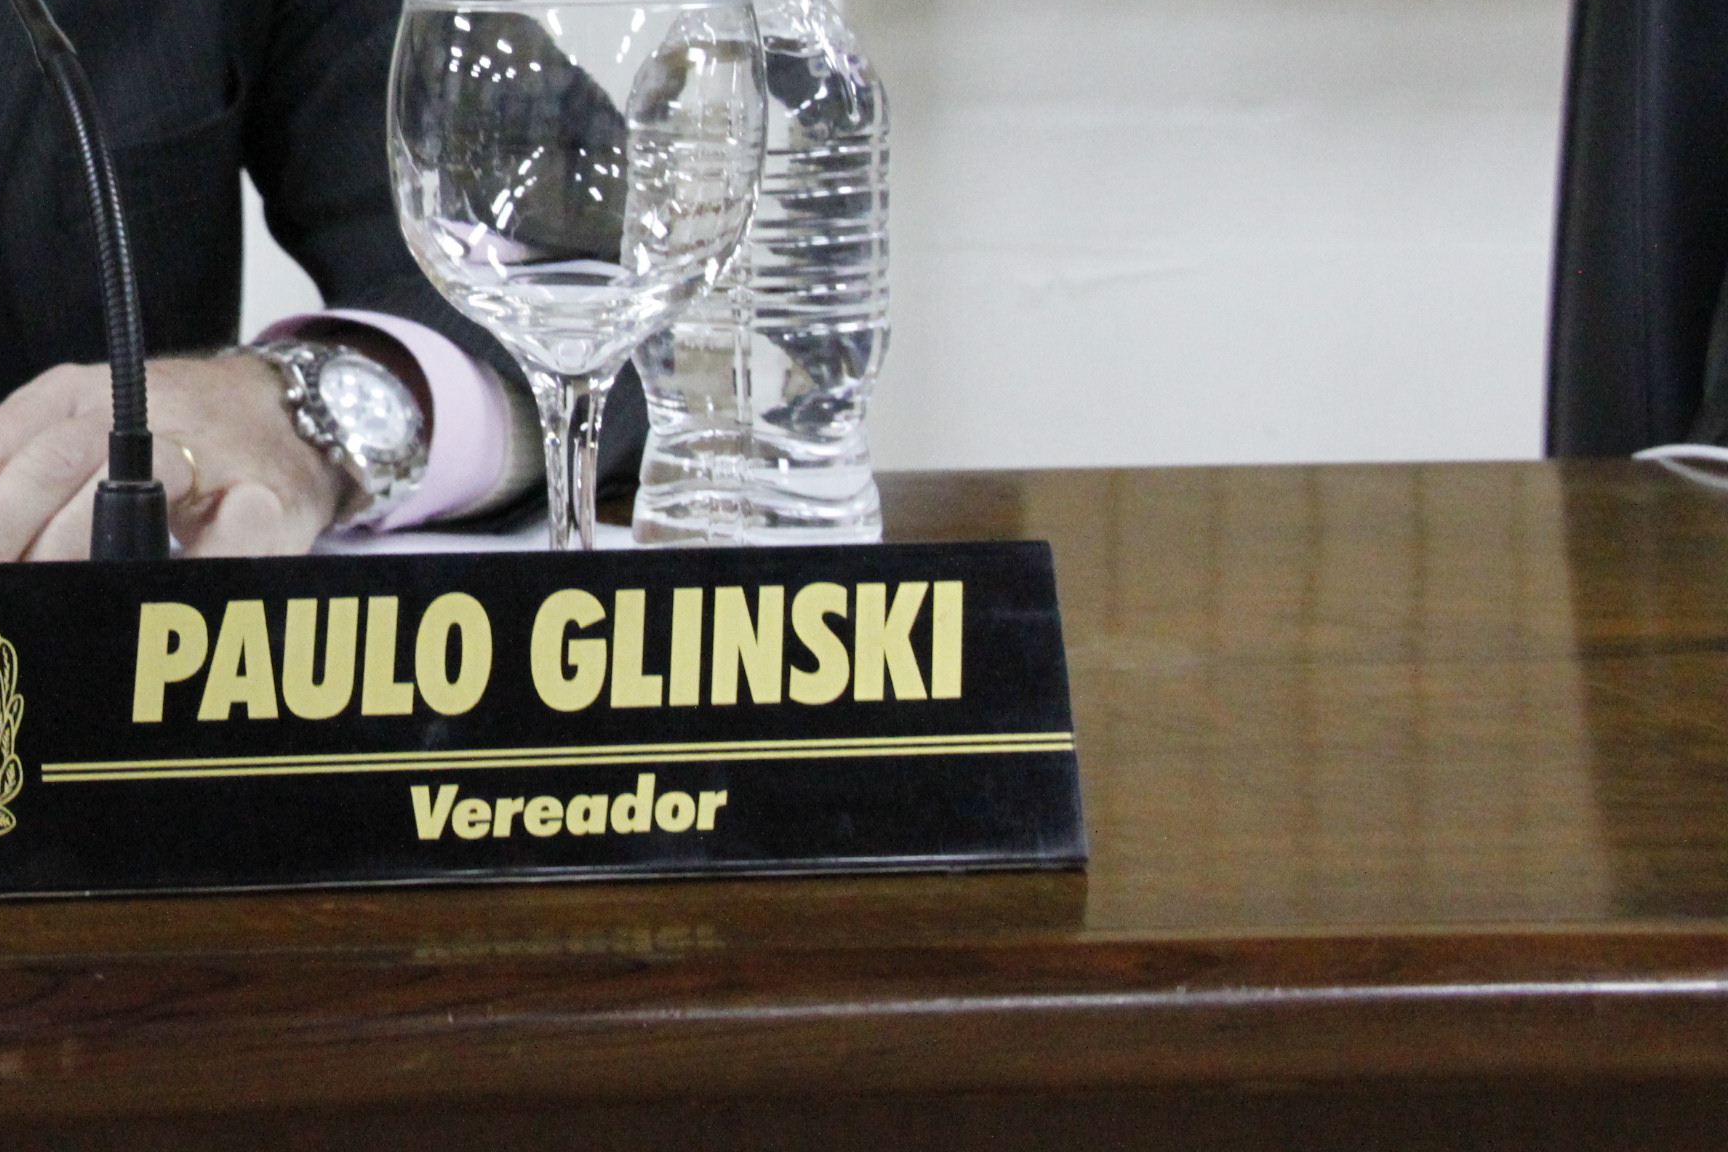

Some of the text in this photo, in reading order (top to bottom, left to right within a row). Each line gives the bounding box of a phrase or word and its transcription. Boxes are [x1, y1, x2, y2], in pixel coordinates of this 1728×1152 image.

[132, 580, 964, 723] PAULO GLINSKI
[410, 773, 728, 840] Vereador
